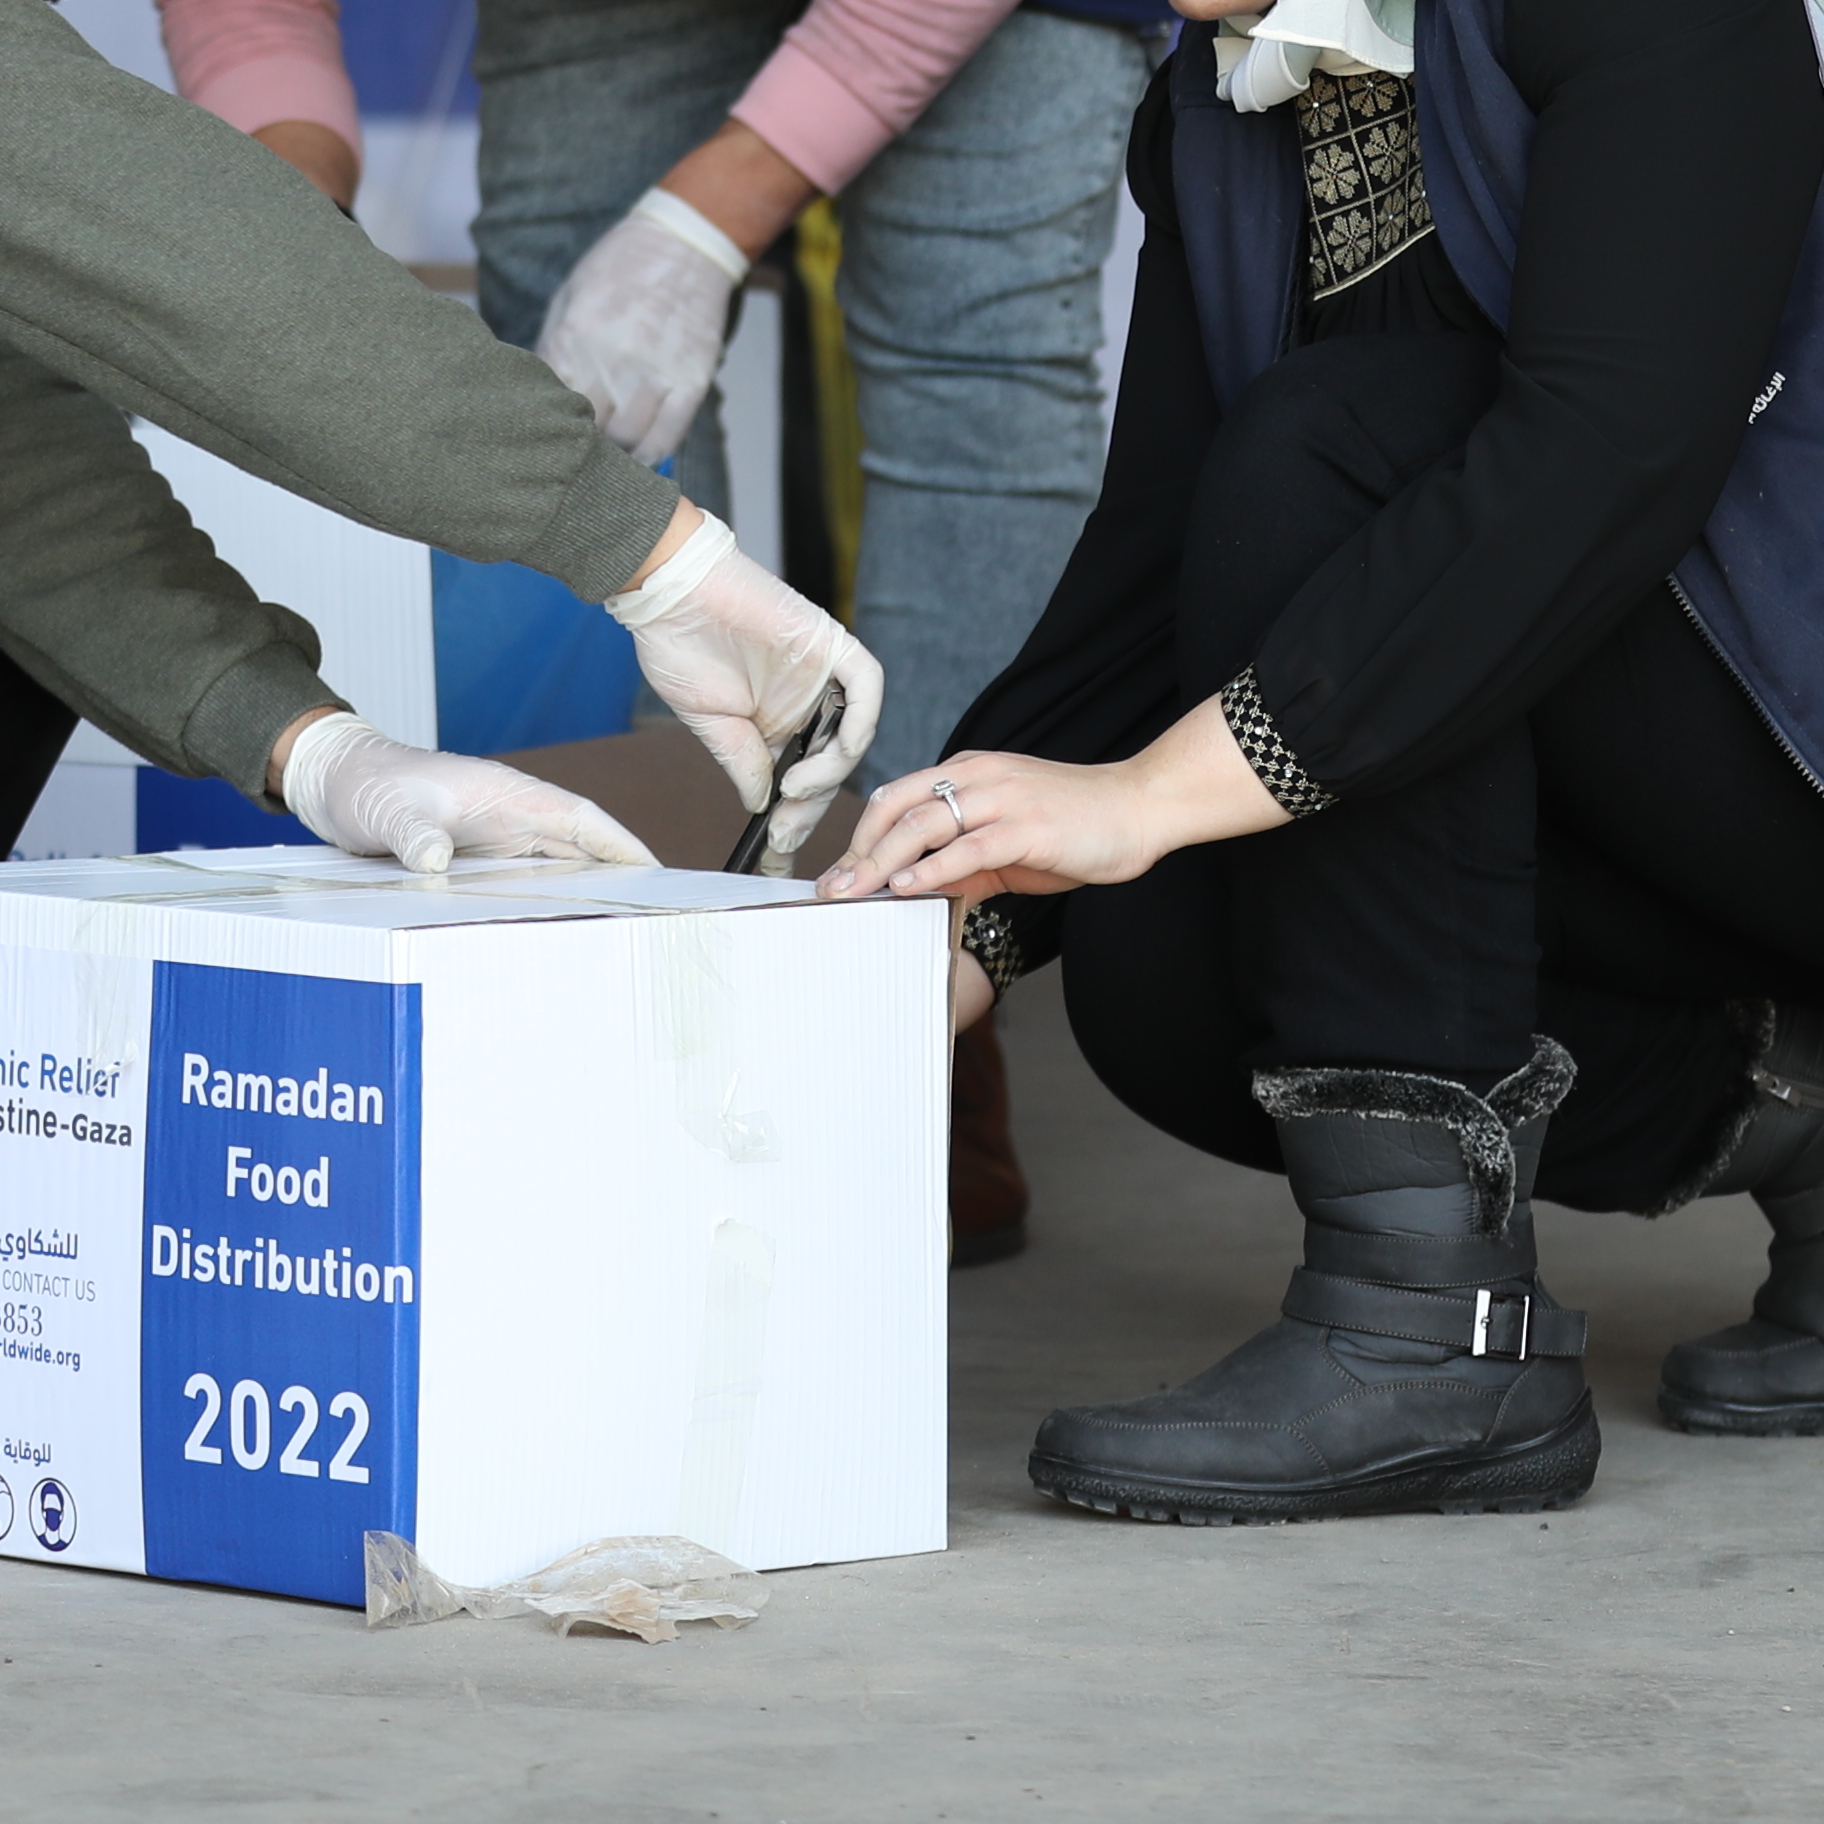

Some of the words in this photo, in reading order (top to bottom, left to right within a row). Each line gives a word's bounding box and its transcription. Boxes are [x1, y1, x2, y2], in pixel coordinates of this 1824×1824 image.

[40, 1053, 121, 1099] Relief
[181, 1052, 385, 1126] Ramadan
[225, 1146, 330, 1209] Food
[2, 1269, 71, 1298] CONTACT
[75, 1278, 96, 1302] US
[151, 1224, 415, 1305] Distribution
[4, 1437, 52, 1467] للوقاية
[182, 1372, 371, 1485] 2022
